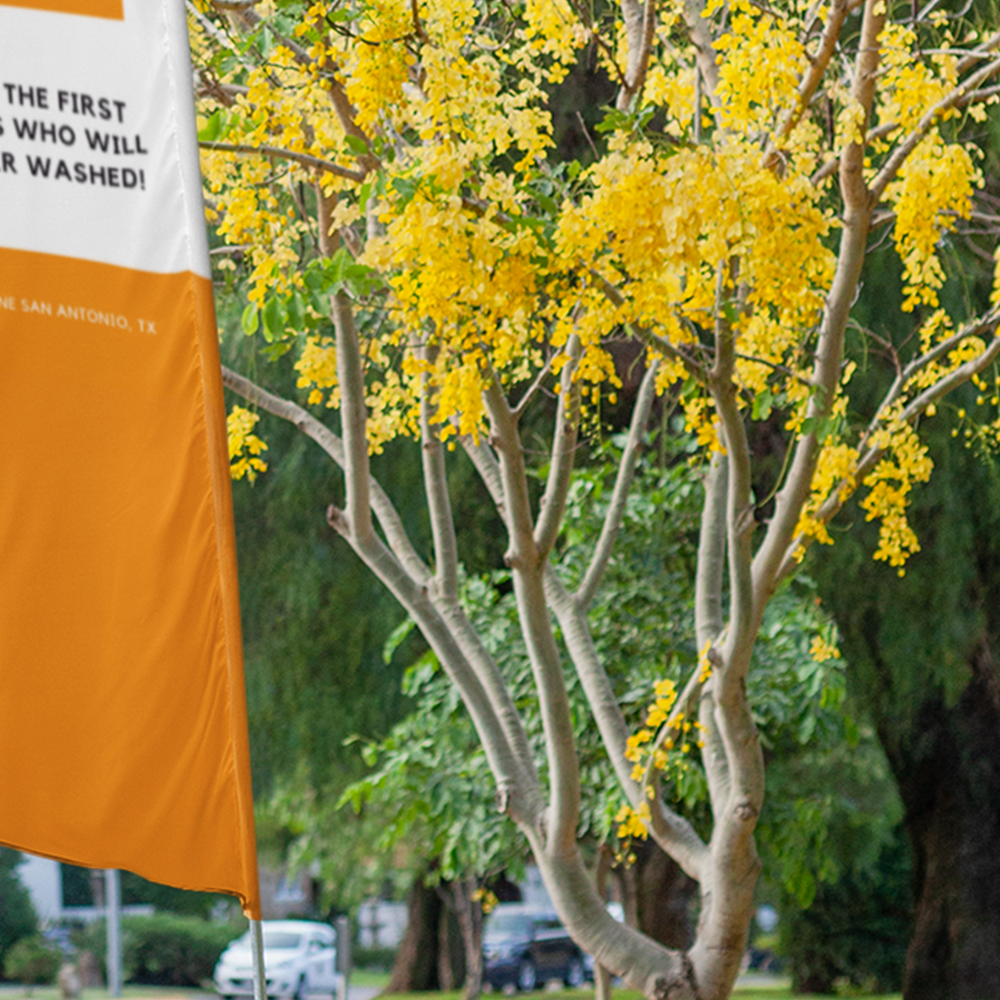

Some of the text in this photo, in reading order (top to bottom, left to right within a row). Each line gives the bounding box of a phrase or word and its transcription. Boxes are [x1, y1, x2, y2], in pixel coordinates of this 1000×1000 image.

[3, 83, 49, 109] THE
[57, 90, 126, 123] FIRST
[13, 118, 76, 146] WHO
[84, 128, 148, 155] WILL
[26, 155, 147, 191] WASHED!
[21, 299, 53, 317] SAN
[56, 304, 134, 333] ANTONIO,
[138, 319, 158, 335] TX
